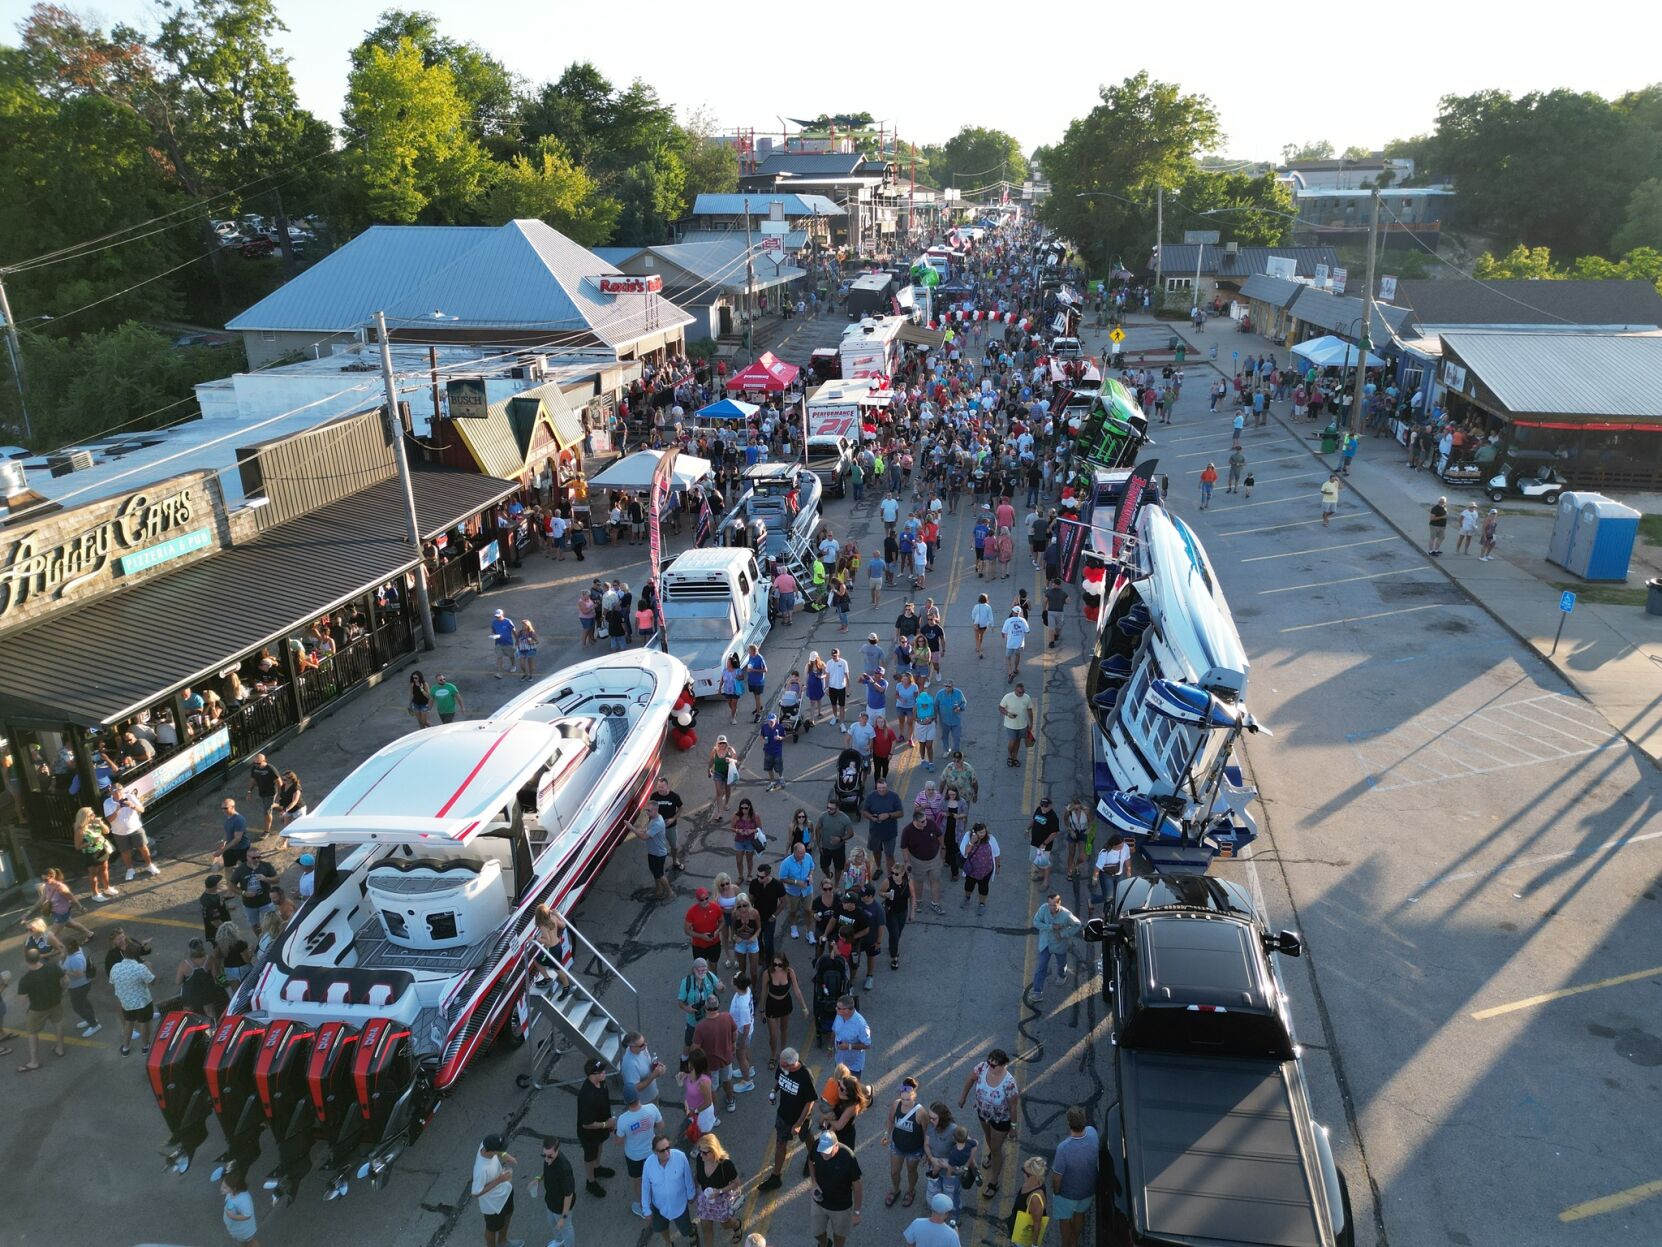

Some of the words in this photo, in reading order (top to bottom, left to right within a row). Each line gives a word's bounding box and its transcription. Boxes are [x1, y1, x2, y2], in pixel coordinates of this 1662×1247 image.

[600, 279, 644, 292] Roxie's
[812, 410, 854, 418] PERFORMANCE
[816, 418, 855, 435] 21
[120, 491, 193, 547] CATS
[126, 544, 175, 570] PIZZERIA
[189, 533, 209, 547] PUB
